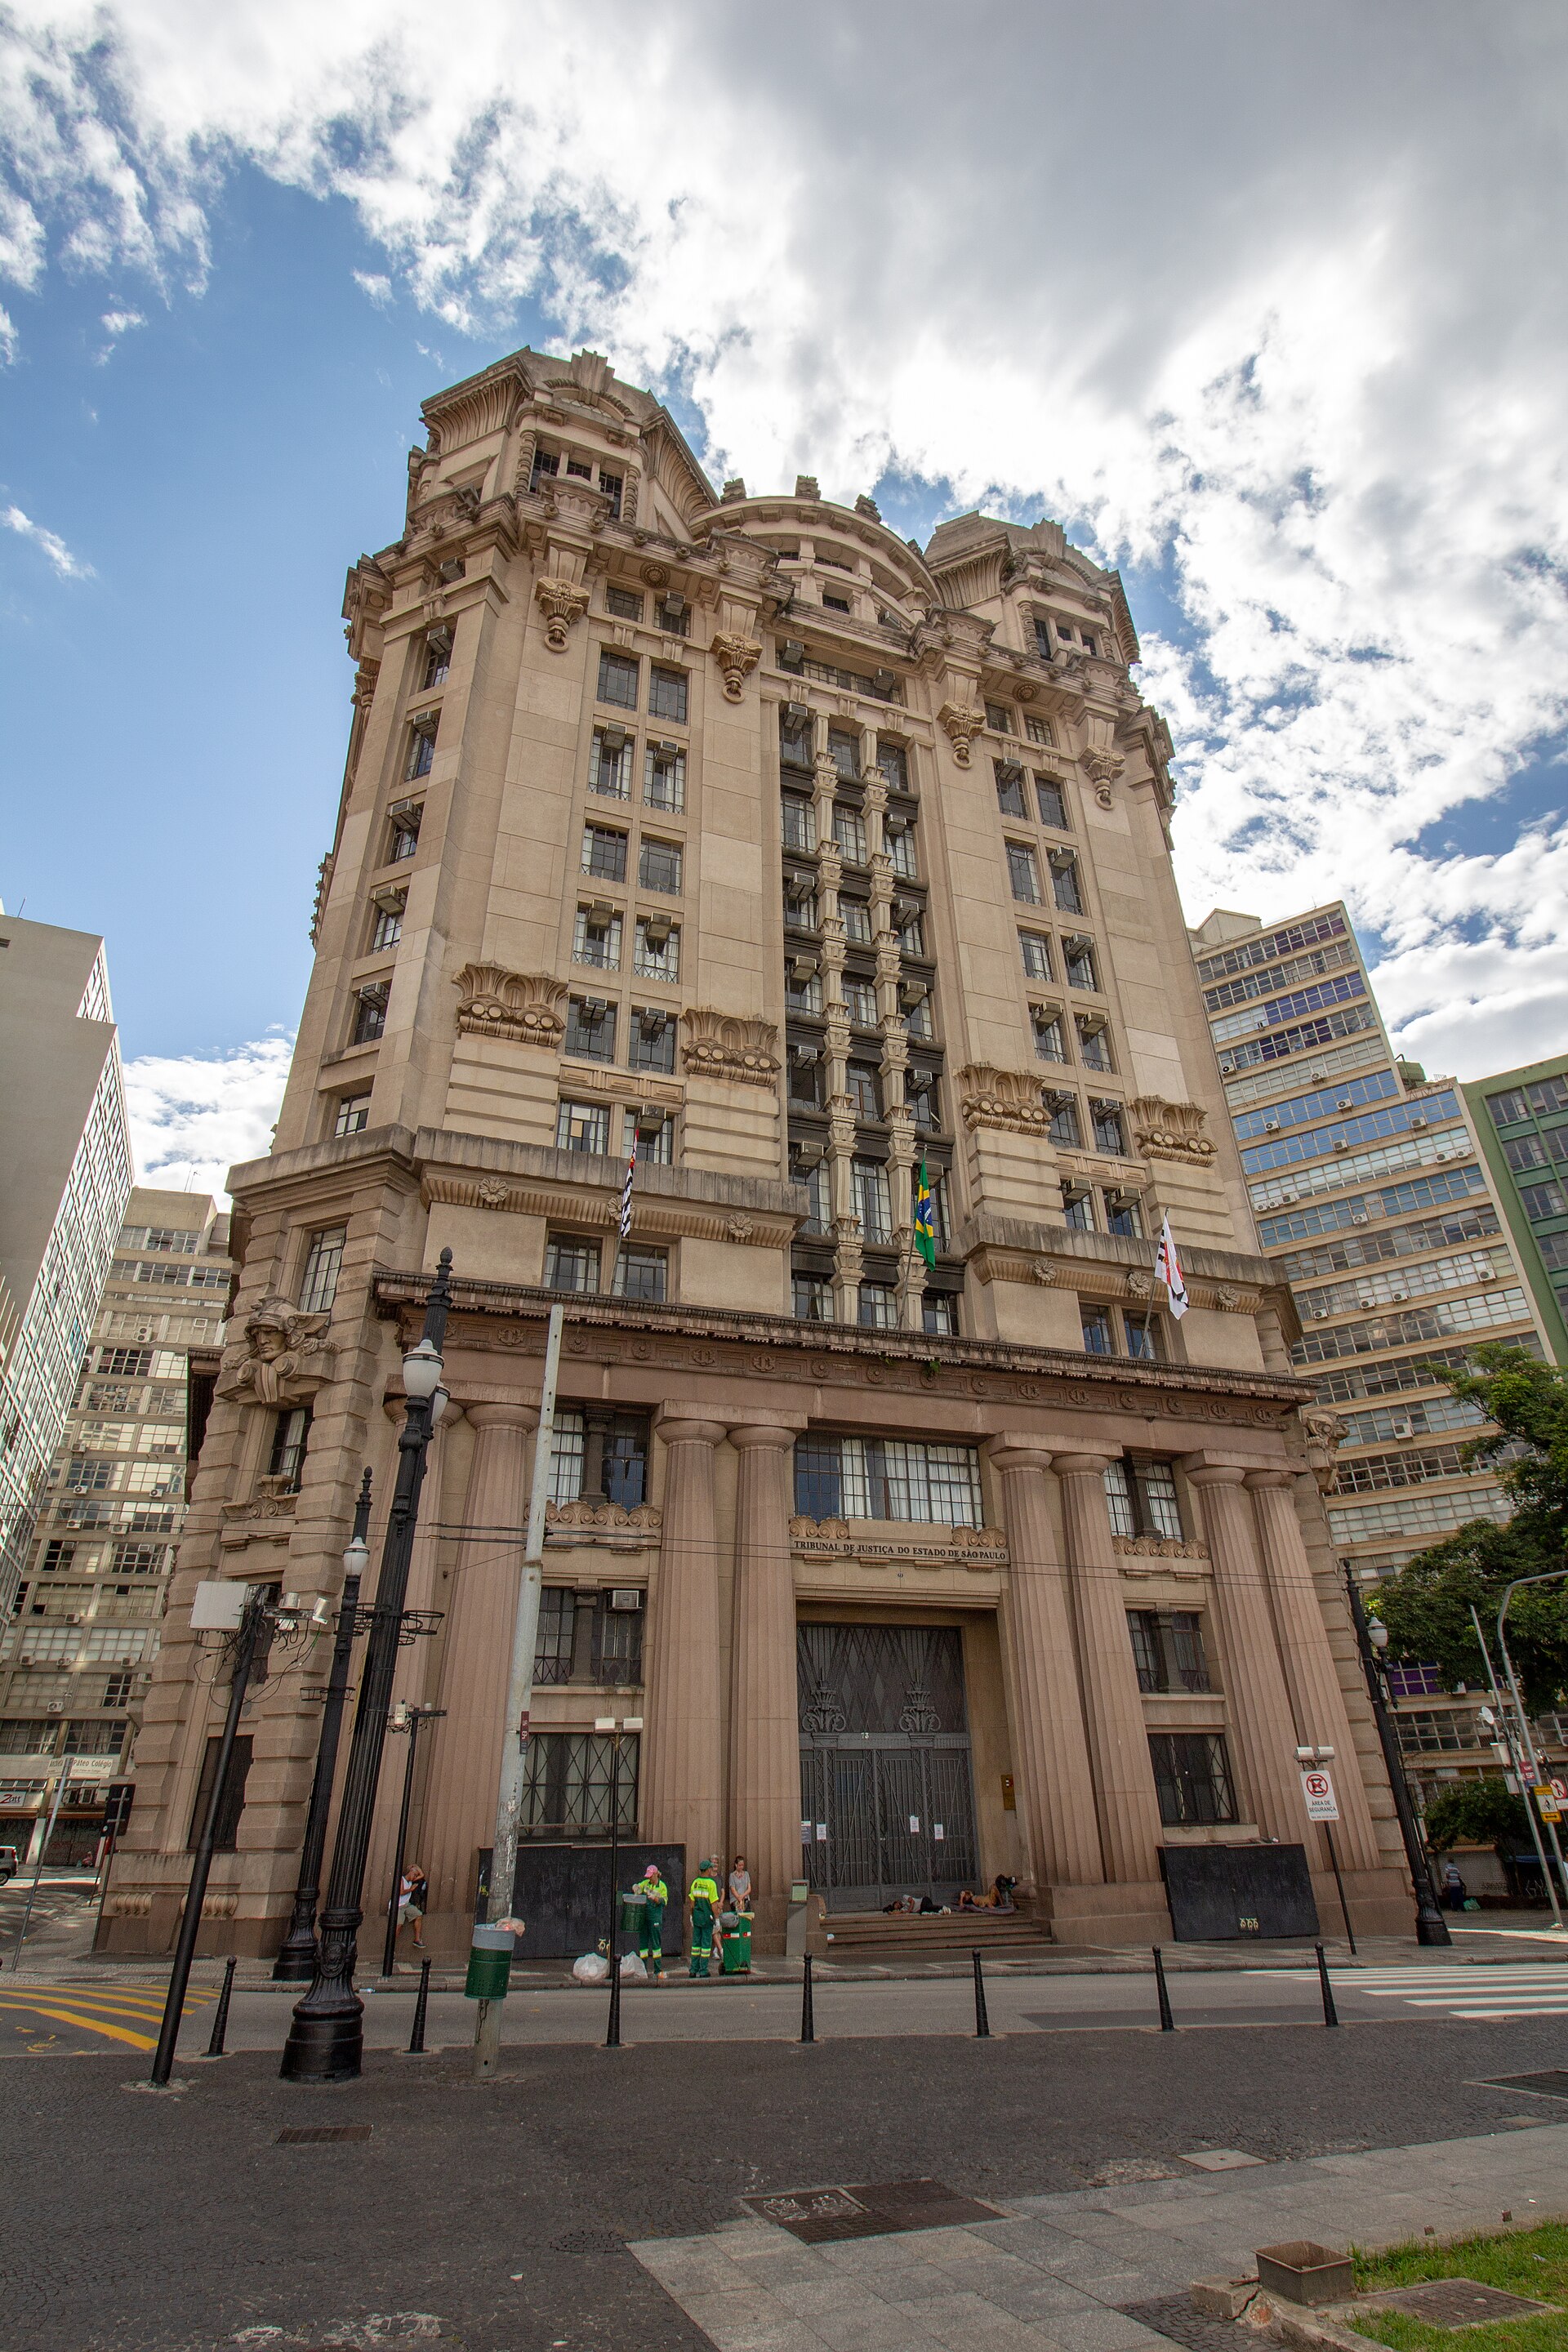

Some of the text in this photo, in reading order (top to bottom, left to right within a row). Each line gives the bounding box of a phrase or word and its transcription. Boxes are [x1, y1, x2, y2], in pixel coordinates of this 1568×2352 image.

[795, 1540, 840, 1550] TRIBUNAL
[857, 1545, 894, 1554] JUSTIÇA
[898, 1546, 910, 1554] DO
[912, 1548, 946, 1557] ESTADO
[979, 1551, 1005, 1559] PAULO
[73, 1759, 112, 1769] Páteo Colégio
